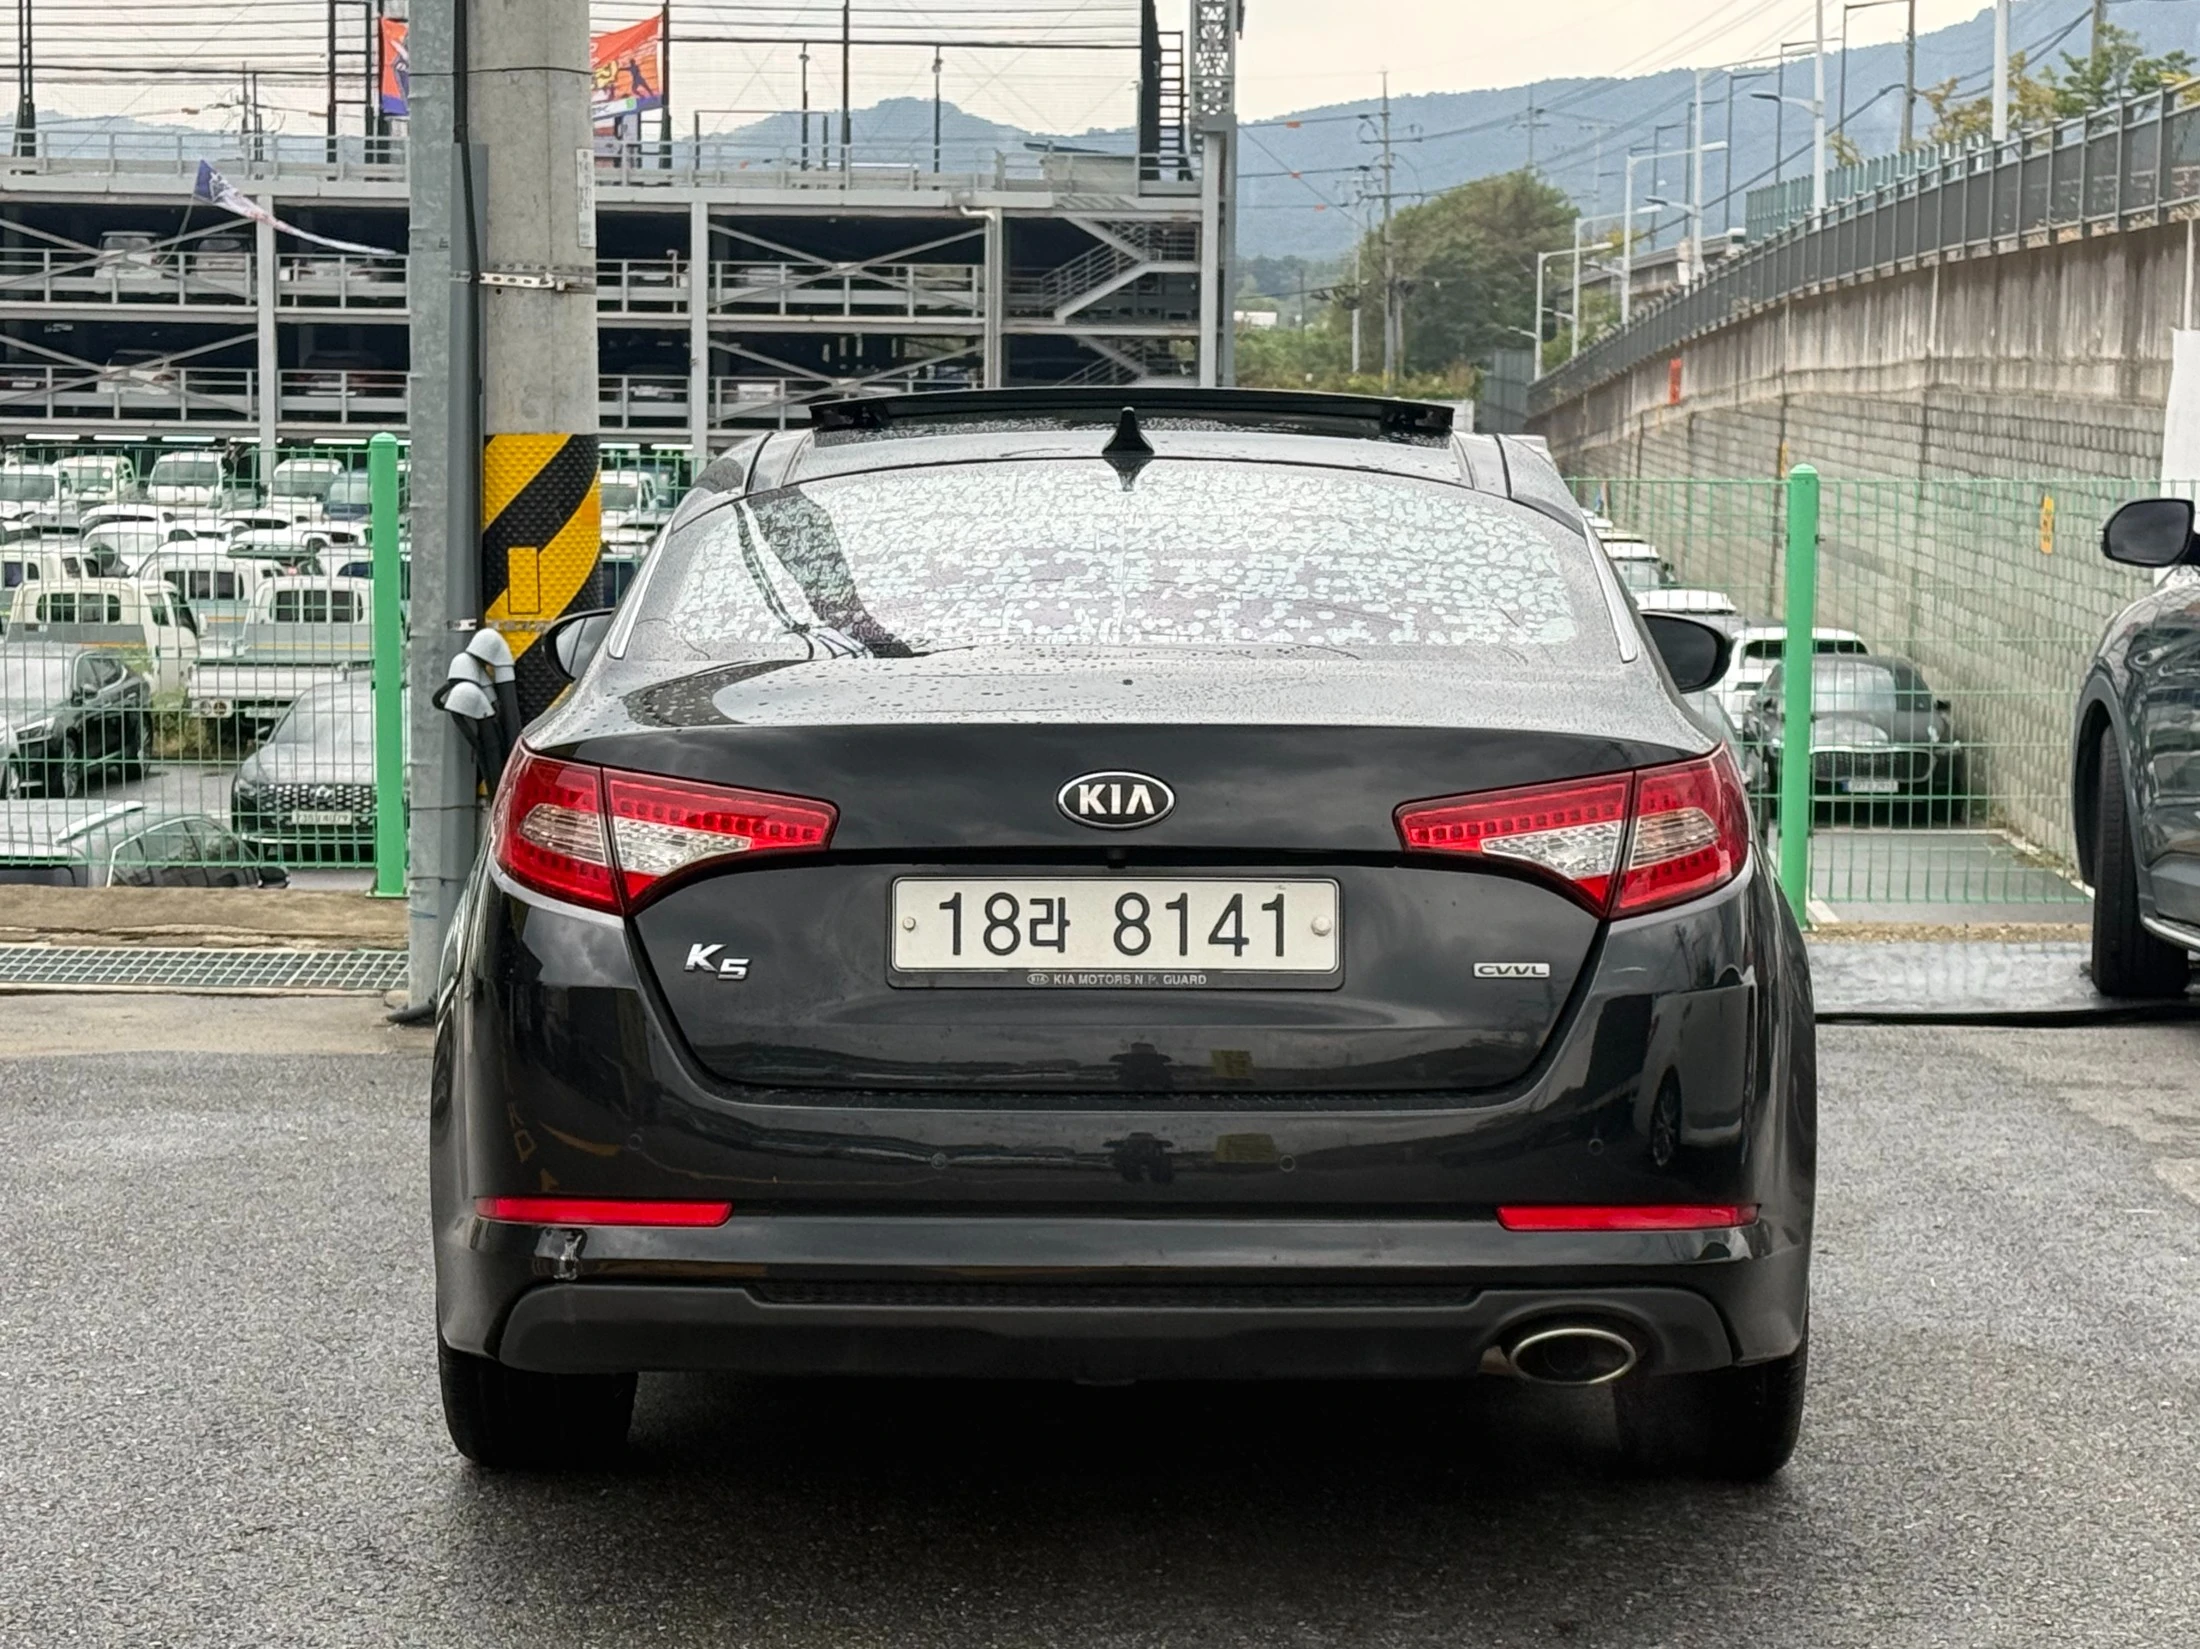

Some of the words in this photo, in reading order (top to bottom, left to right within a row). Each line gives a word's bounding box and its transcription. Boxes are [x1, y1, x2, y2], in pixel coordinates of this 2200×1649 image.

[1077, 784, 1156, 815] KIA
[938, 891, 1071, 956] 18라
[1113, 891, 1286, 957] 8141
[683, 943, 750, 980] K5
[1476, 964, 1548, 976] CVVL
[1053, 973, 1076, 985] KIA
[1078, 973, 1131, 985] MOTORS
[1163, 973, 1207, 985] GUARD
